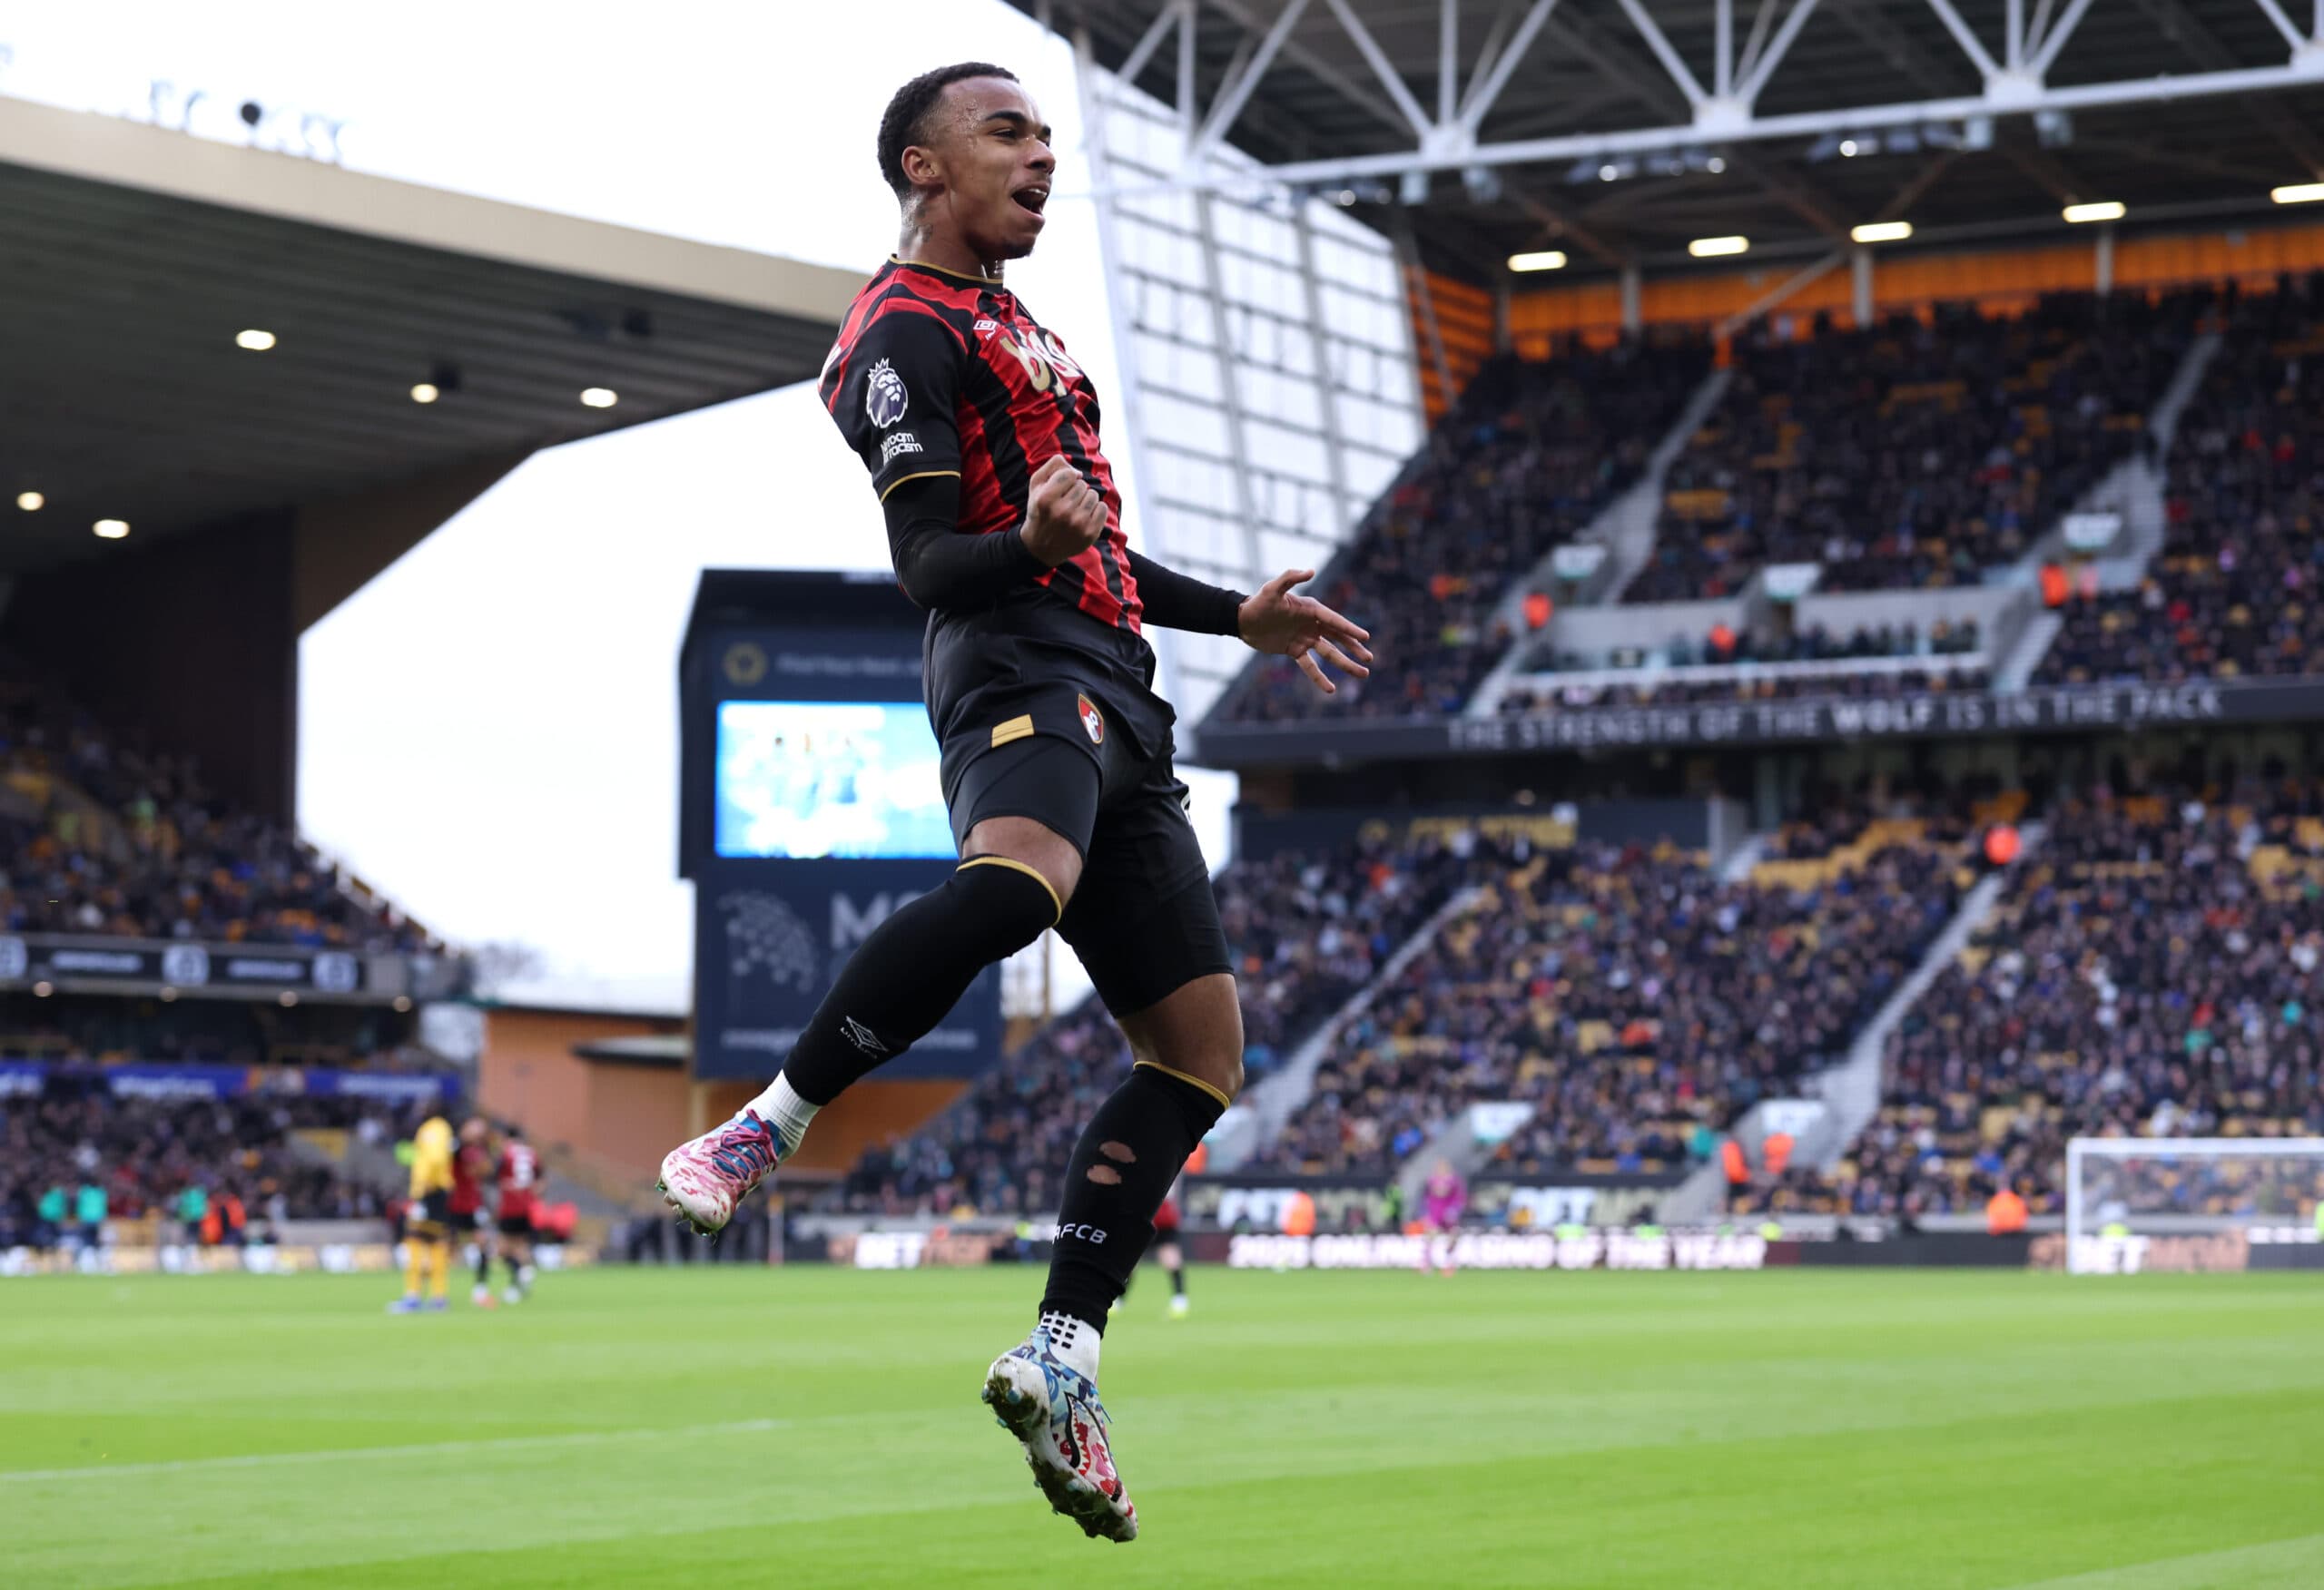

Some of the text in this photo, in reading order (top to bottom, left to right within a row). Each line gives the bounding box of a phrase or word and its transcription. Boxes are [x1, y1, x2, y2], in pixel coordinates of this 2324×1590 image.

[1449, 684, 2222, 750] THE STRENGTH OF THE WOLF IS IN THE PACK
[1556, 1233, 1605, 1269] OF
[1606, 1233, 1670, 1269] THE
[1673, 1233, 1767, 1269] YEAR
